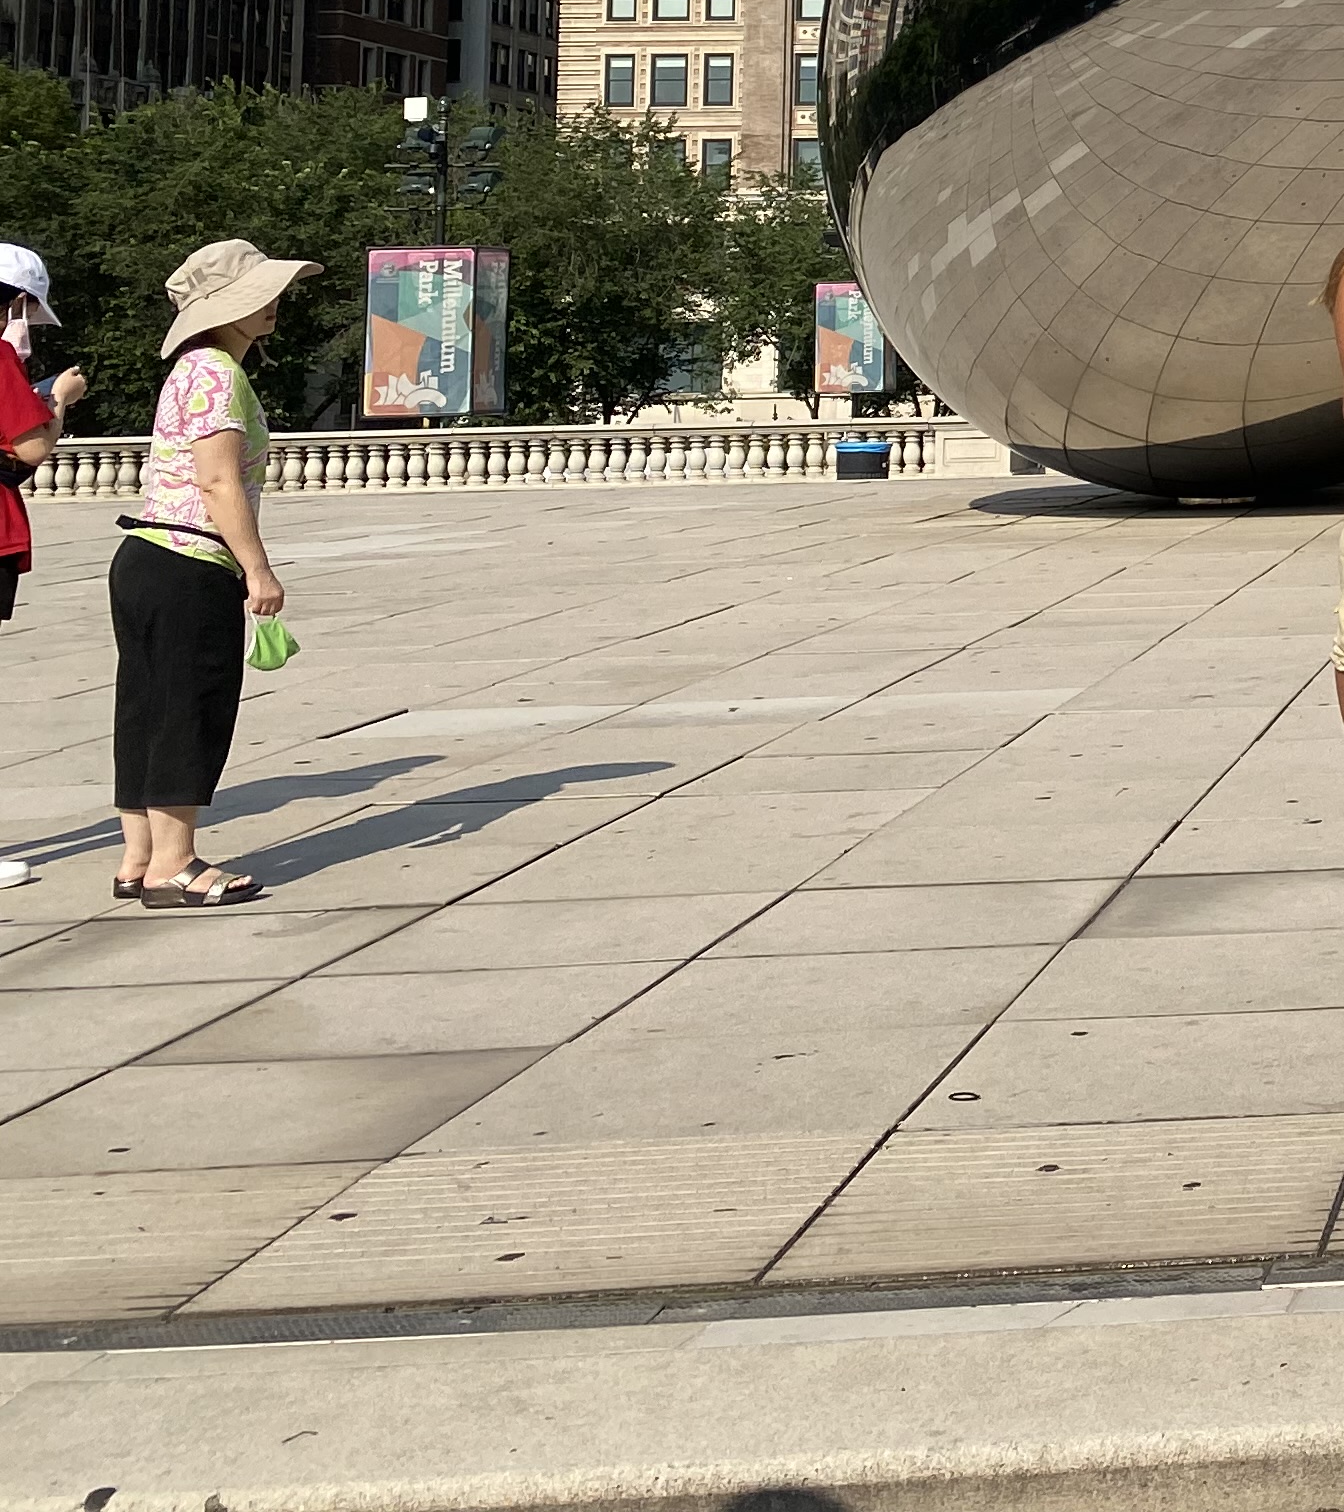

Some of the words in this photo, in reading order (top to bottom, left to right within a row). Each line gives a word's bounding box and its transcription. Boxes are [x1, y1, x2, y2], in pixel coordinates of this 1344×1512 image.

[418, 260, 438, 305] Park
[440, 259, 463, 374] Millennium
[848, 291, 862, 320] Park
